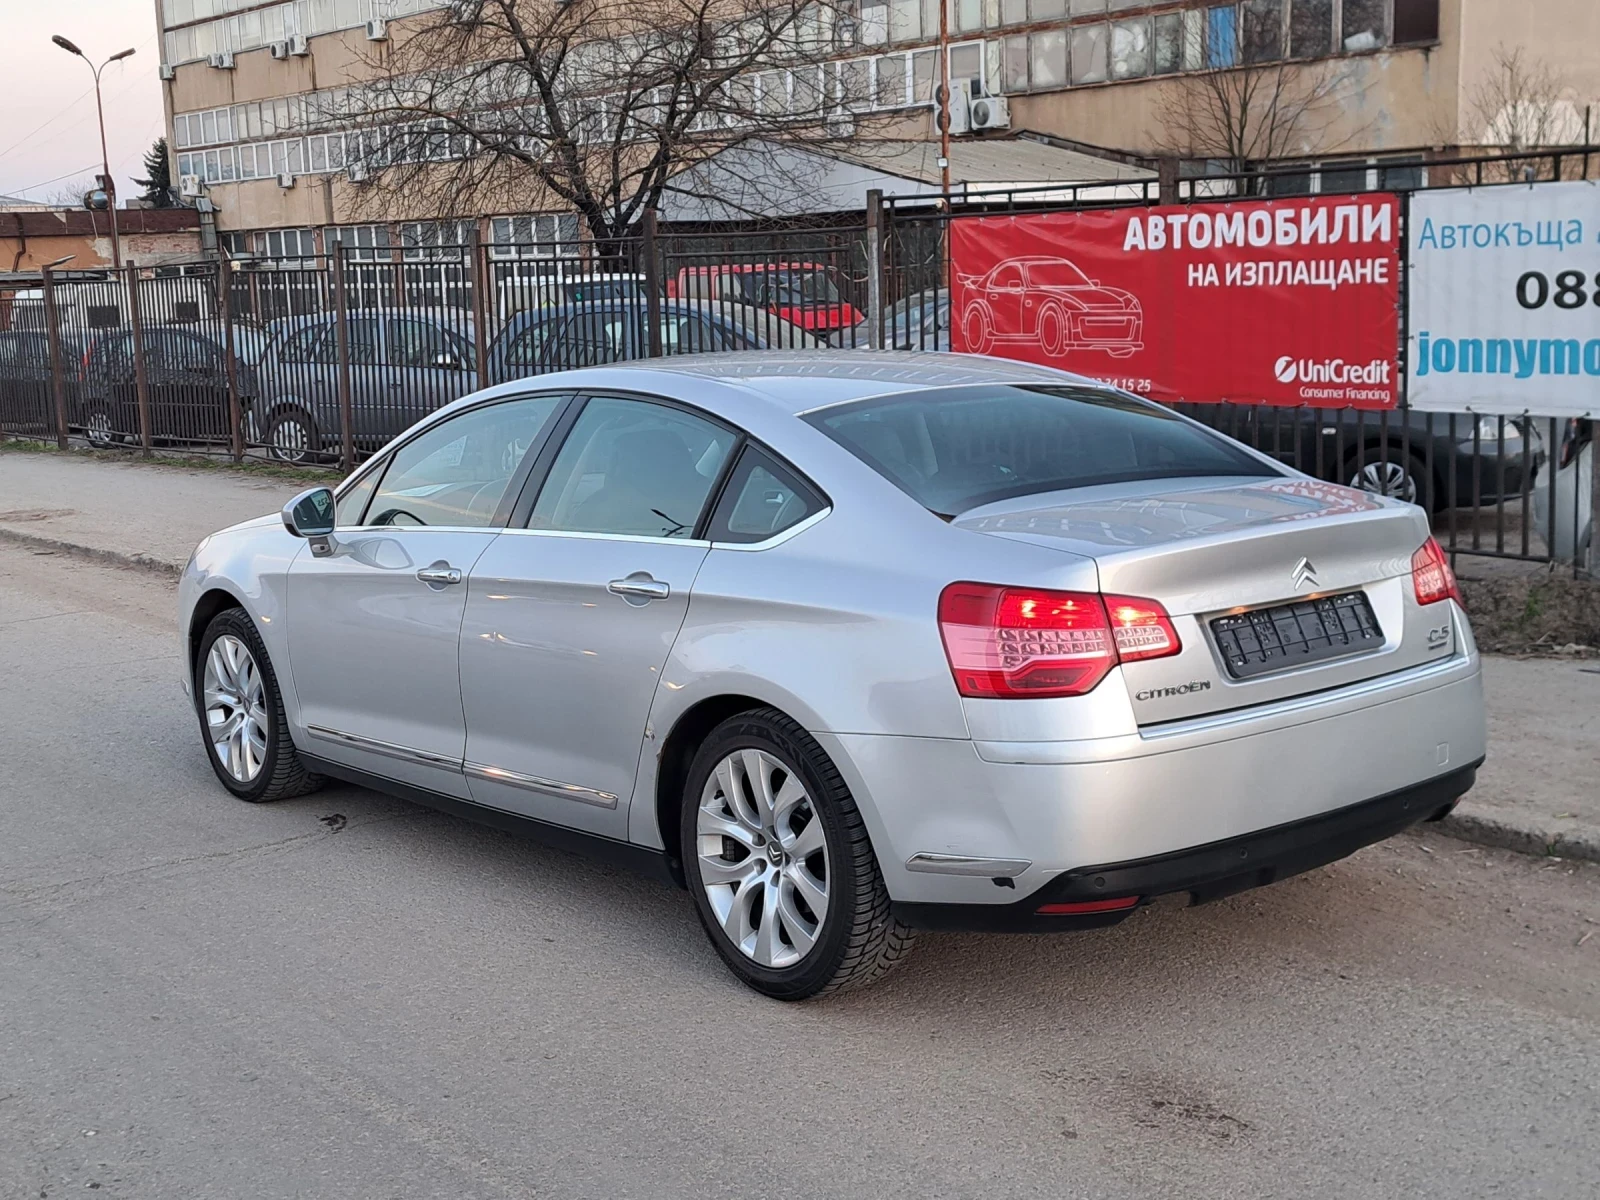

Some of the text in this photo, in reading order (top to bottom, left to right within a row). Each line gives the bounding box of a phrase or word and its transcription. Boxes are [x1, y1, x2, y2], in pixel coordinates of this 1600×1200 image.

[1123, 203, 1392, 251] АВТОМОБИЛИ
[1418, 217, 1583, 251] Автокъща
[1188, 258, 1389, 290] НА ИЗПЛАЩАНЕ
[1516, 269, 1600, 310] 08
[1300, 358, 1390, 384] UniCredit
[1121, 378, 1135, 391] 15
[1137, 379, 1152, 392] 25
[1300, 386, 1391, 403] Consumer Financing
[1428, 625, 1450, 643] C5
[1135, 679, 1211, 701] CITROËN
